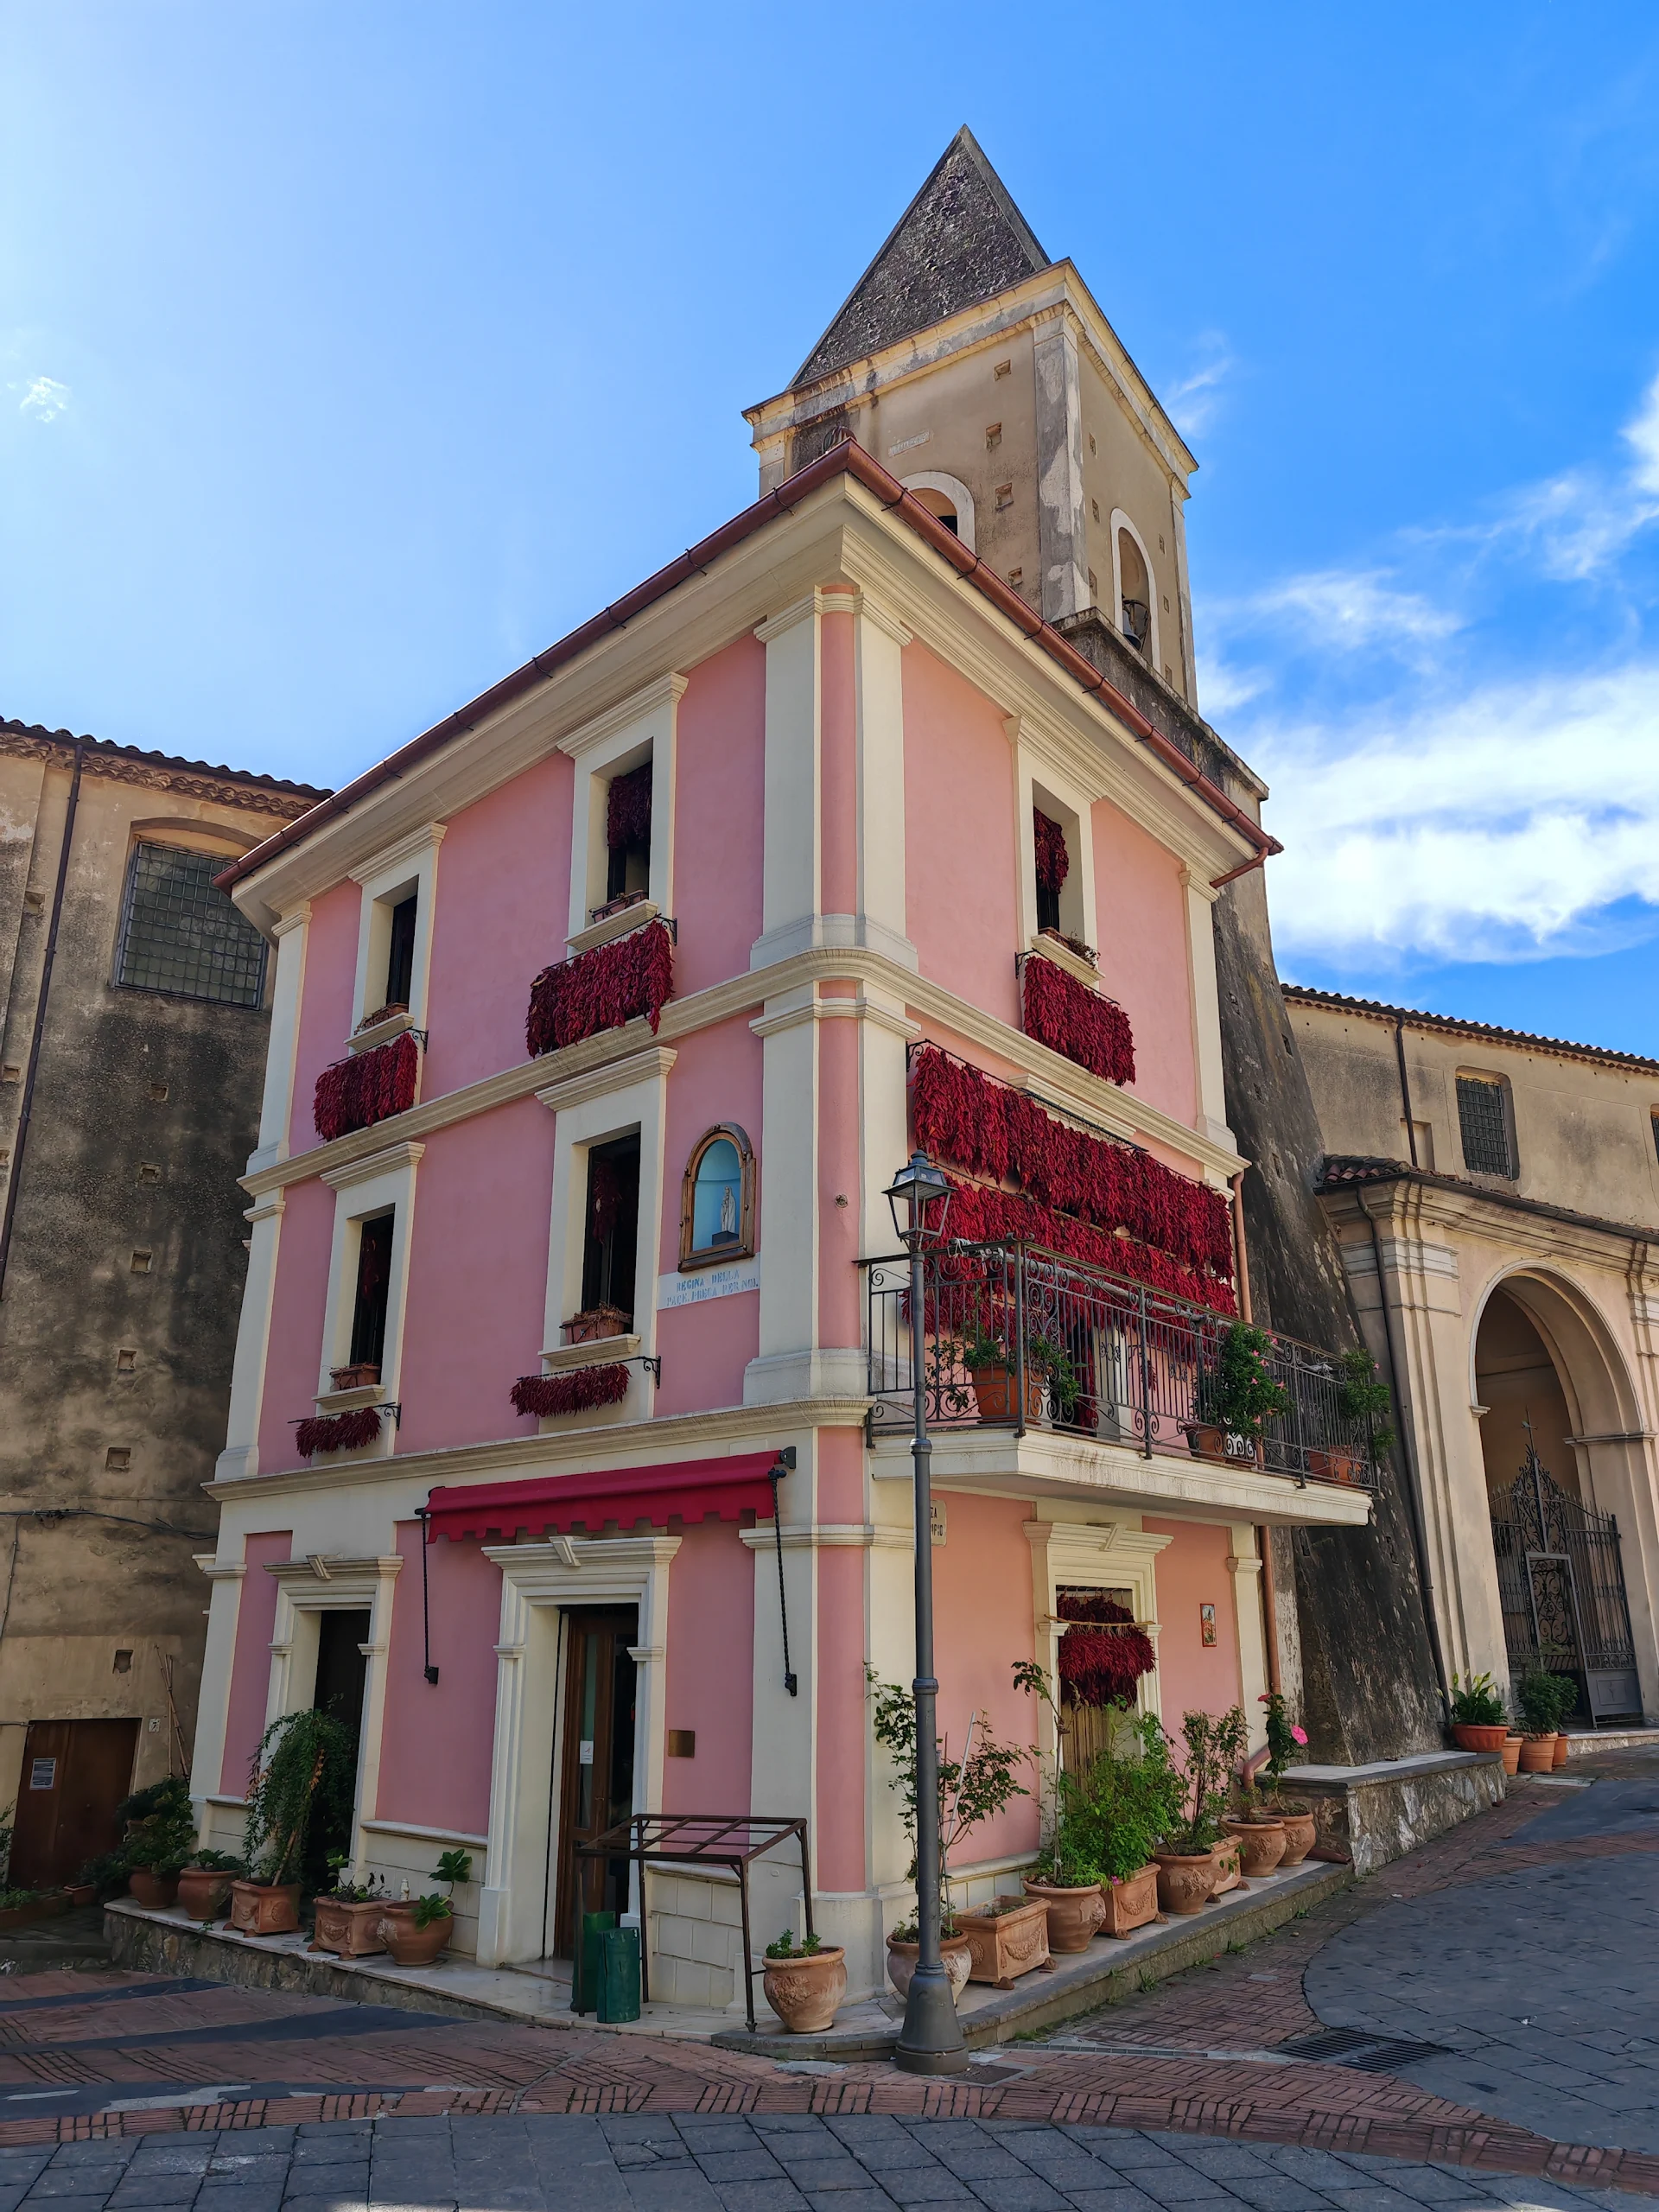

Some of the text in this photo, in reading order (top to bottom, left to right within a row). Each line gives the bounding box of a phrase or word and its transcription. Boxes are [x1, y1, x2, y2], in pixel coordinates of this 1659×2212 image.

[677, 1269, 740, 1293] REGINA DELLA
[722, 1281, 739, 1294] PER
